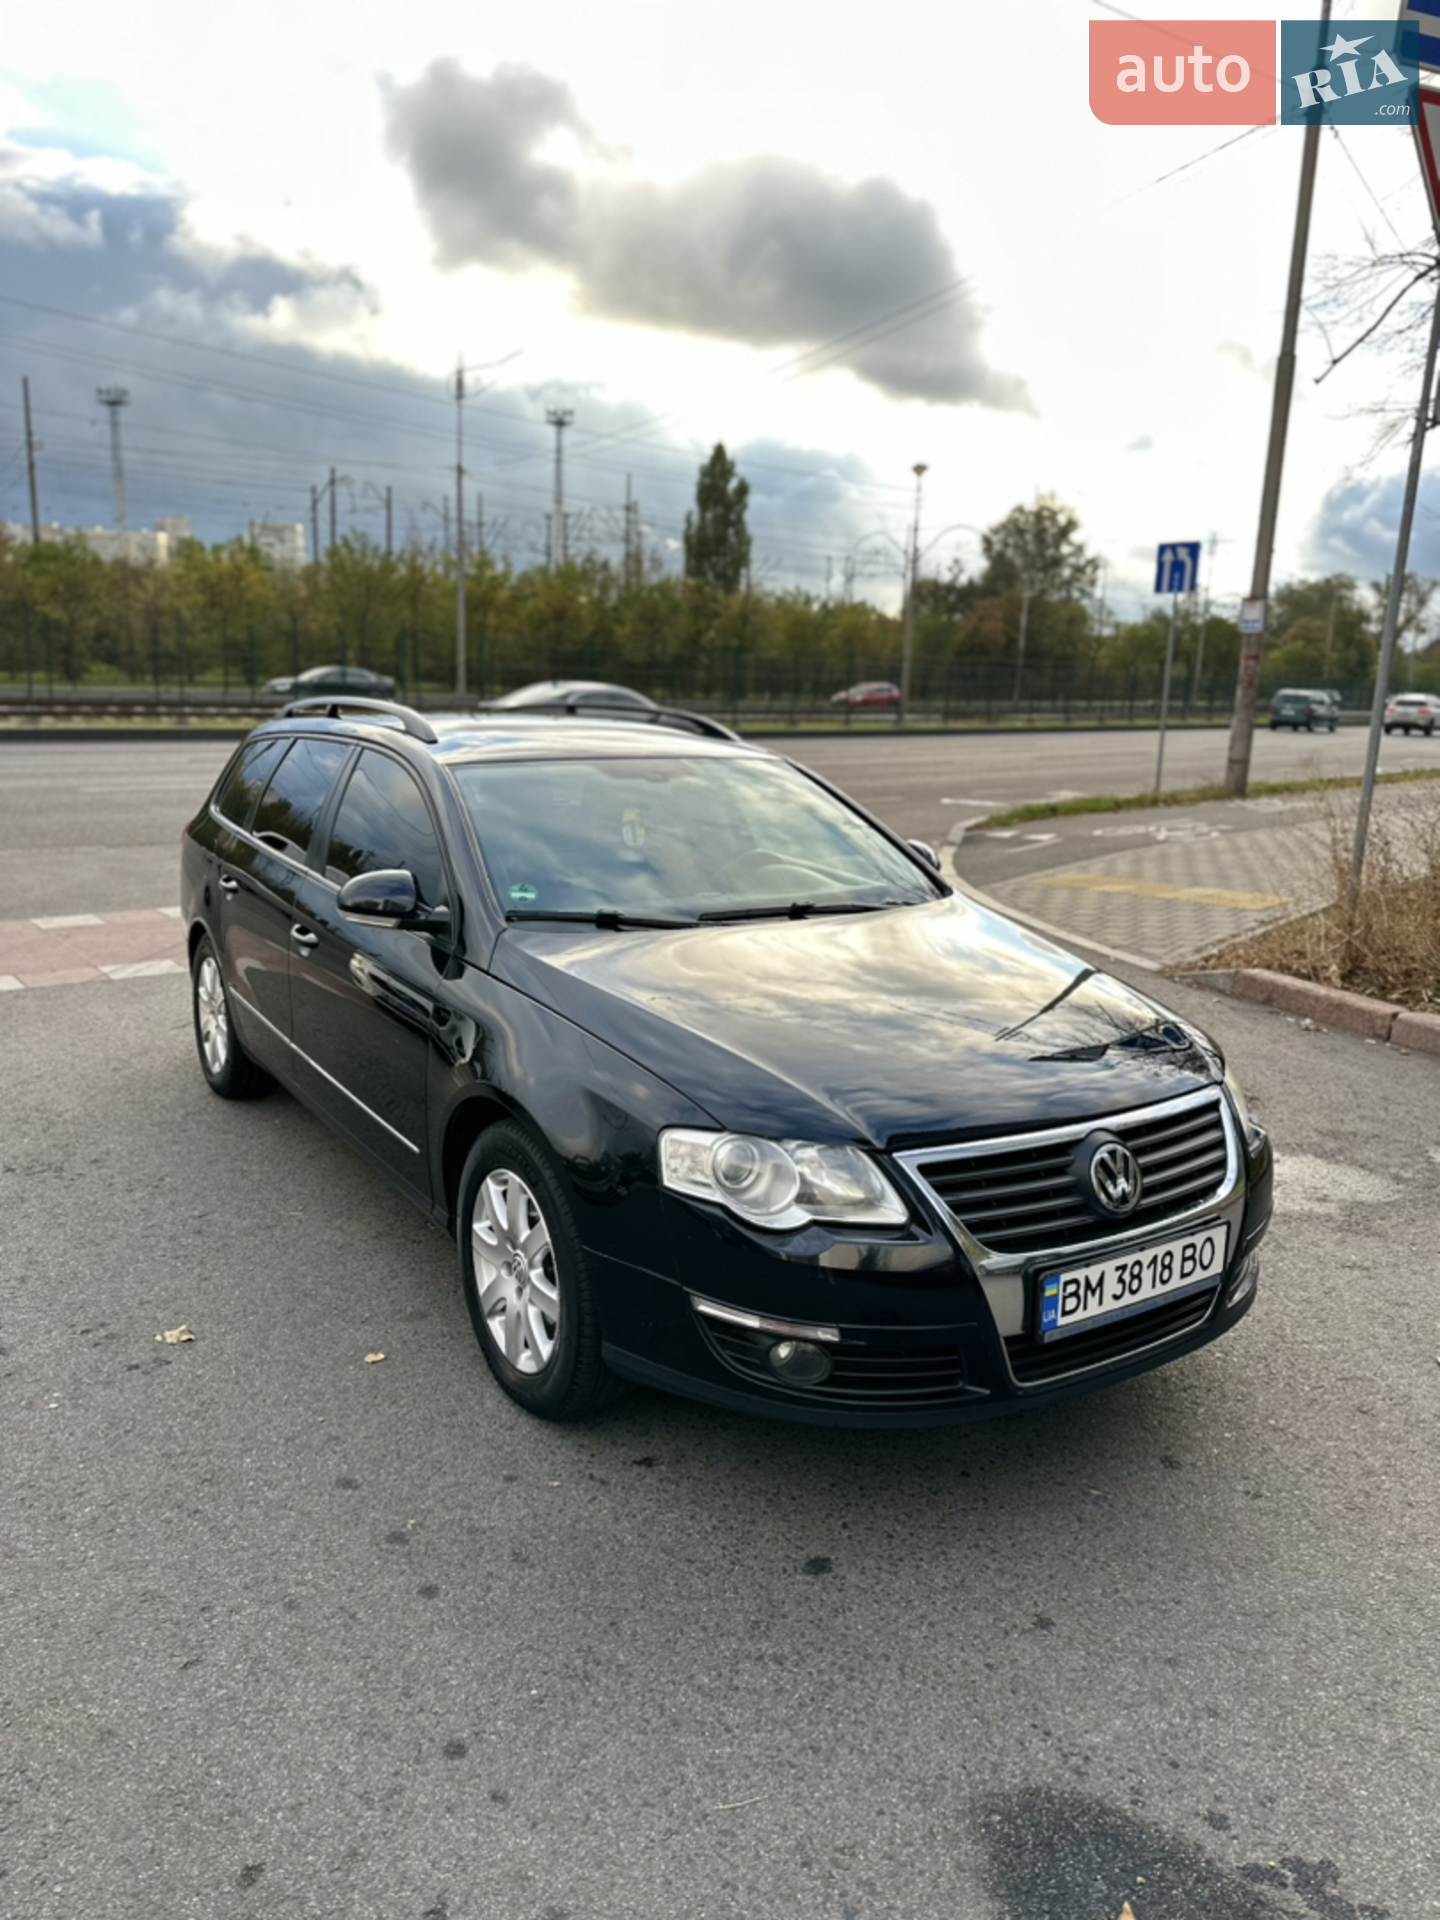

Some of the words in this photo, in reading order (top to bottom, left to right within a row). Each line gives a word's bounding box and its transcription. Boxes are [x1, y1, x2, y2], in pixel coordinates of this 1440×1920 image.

[1060, 1270, 1105, 1318] BM
[1112, 1250, 1174, 1301] 3818
[1180, 1236, 1216, 1280] BO
[1043, 1308, 1057, 1323] UA
